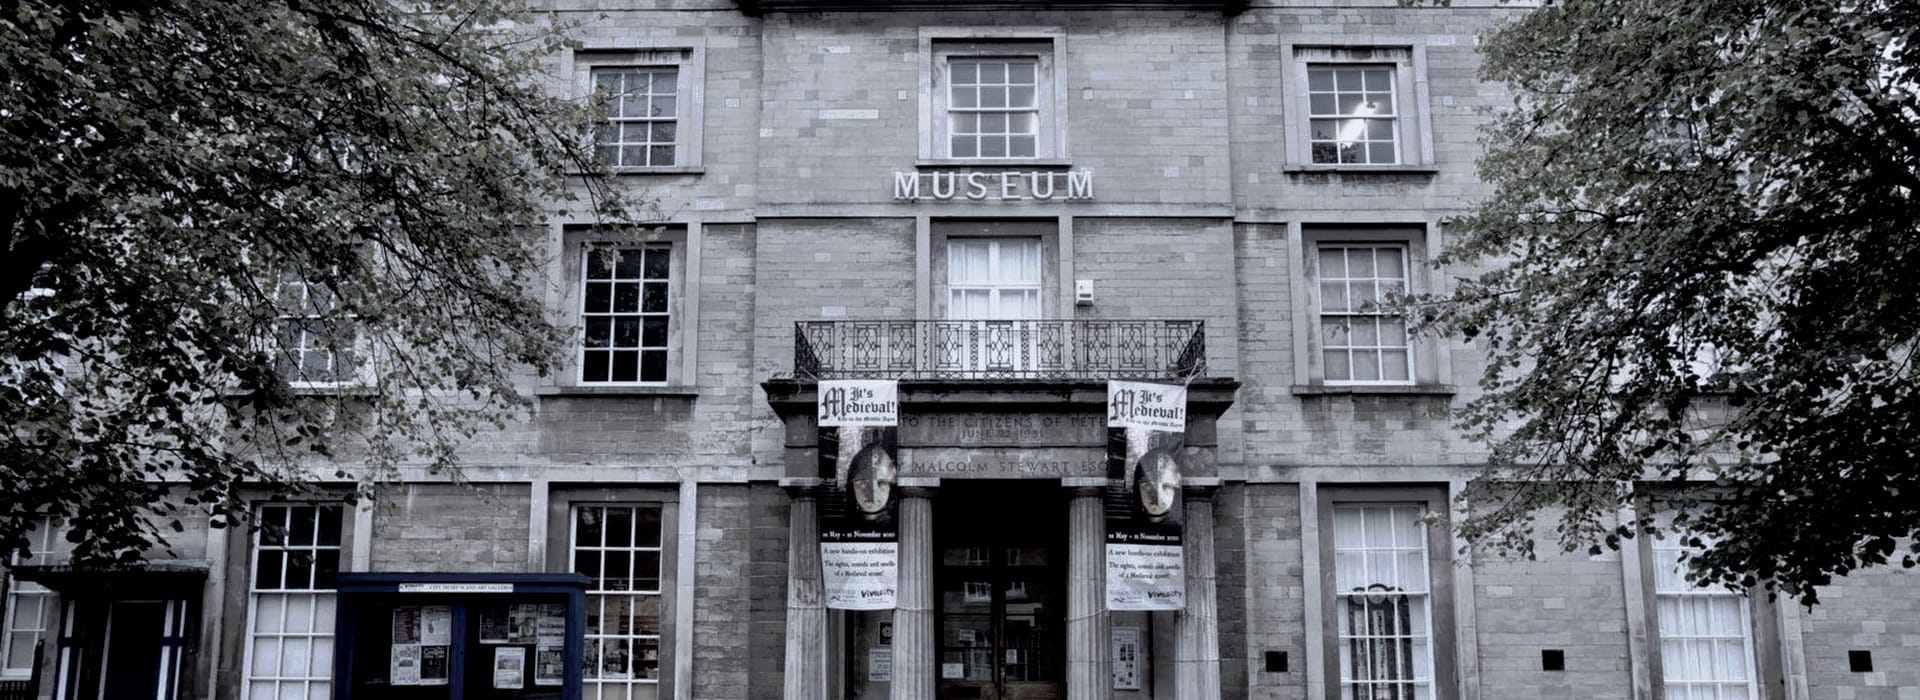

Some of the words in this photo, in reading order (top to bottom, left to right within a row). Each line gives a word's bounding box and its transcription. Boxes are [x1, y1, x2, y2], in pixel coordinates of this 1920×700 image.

[894, 170, 1095, 201] MUSEUM
[849, 387, 873, 401] It's
[1139, 389, 1163, 404] It's
[820, 387, 896, 420] Medieval!
[1110, 389, 1184, 420] Medieval!
[902, 416, 919, 428] TO
[929, 416, 955, 428] THE
[964, 416, 1033, 428] CITIZENS
[1043, 416, 1064, 428] OF
[962, 429, 992, 439] JUNE
[914, 462, 988, 473] MALCOLM
[1000, 462, 1070, 473] STEWART
[829, 530, 840, 540] May
[854, 530, 881, 538] November
